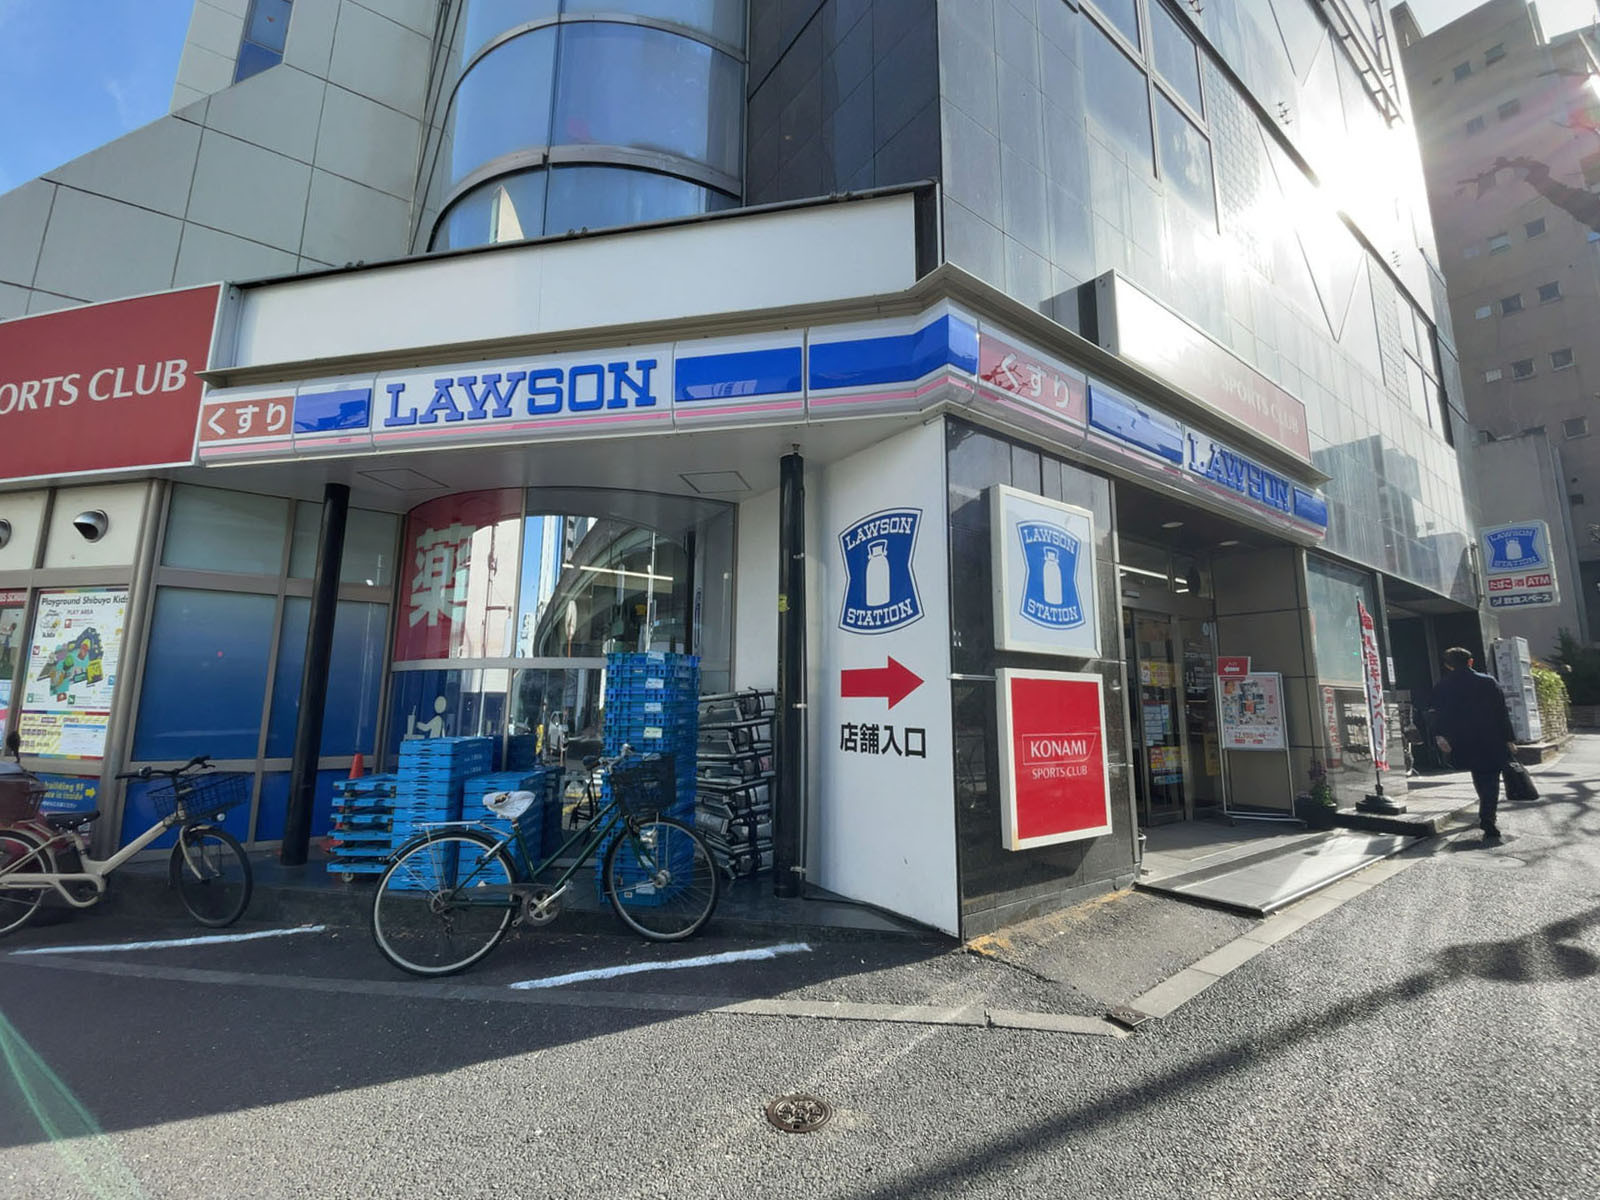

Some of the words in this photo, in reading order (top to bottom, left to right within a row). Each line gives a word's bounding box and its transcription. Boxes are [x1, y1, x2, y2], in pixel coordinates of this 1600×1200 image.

[88, 359, 188, 400] CLUB
[384, 359, 657, 427] LAWSON
[1000, 352, 1069, 408] くすり
[207, 402, 286, 435] くすり
[1187, 433, 1290, 513] LAWSON
[845, 517, 913, 550] LAWSON
[1023, 527, 1077, 556] LAWSON
[408, 523, 476, 627] 薬
[1528, 575, 1549, 586] ATM
[41, 596, 80, 607] Playground
[82, 596, 111, 606] Shibuya
[846, 599, 913, 626] STATION
[1027, 598, 1079, 623] STATION
[840, 723, 926, 758] 店舗入口
[1030, 740, 1087, 759] KONAMI
[1032, 767, 1065, 779] SPORTS
[1066, 765, 1087, 777] CLUB
